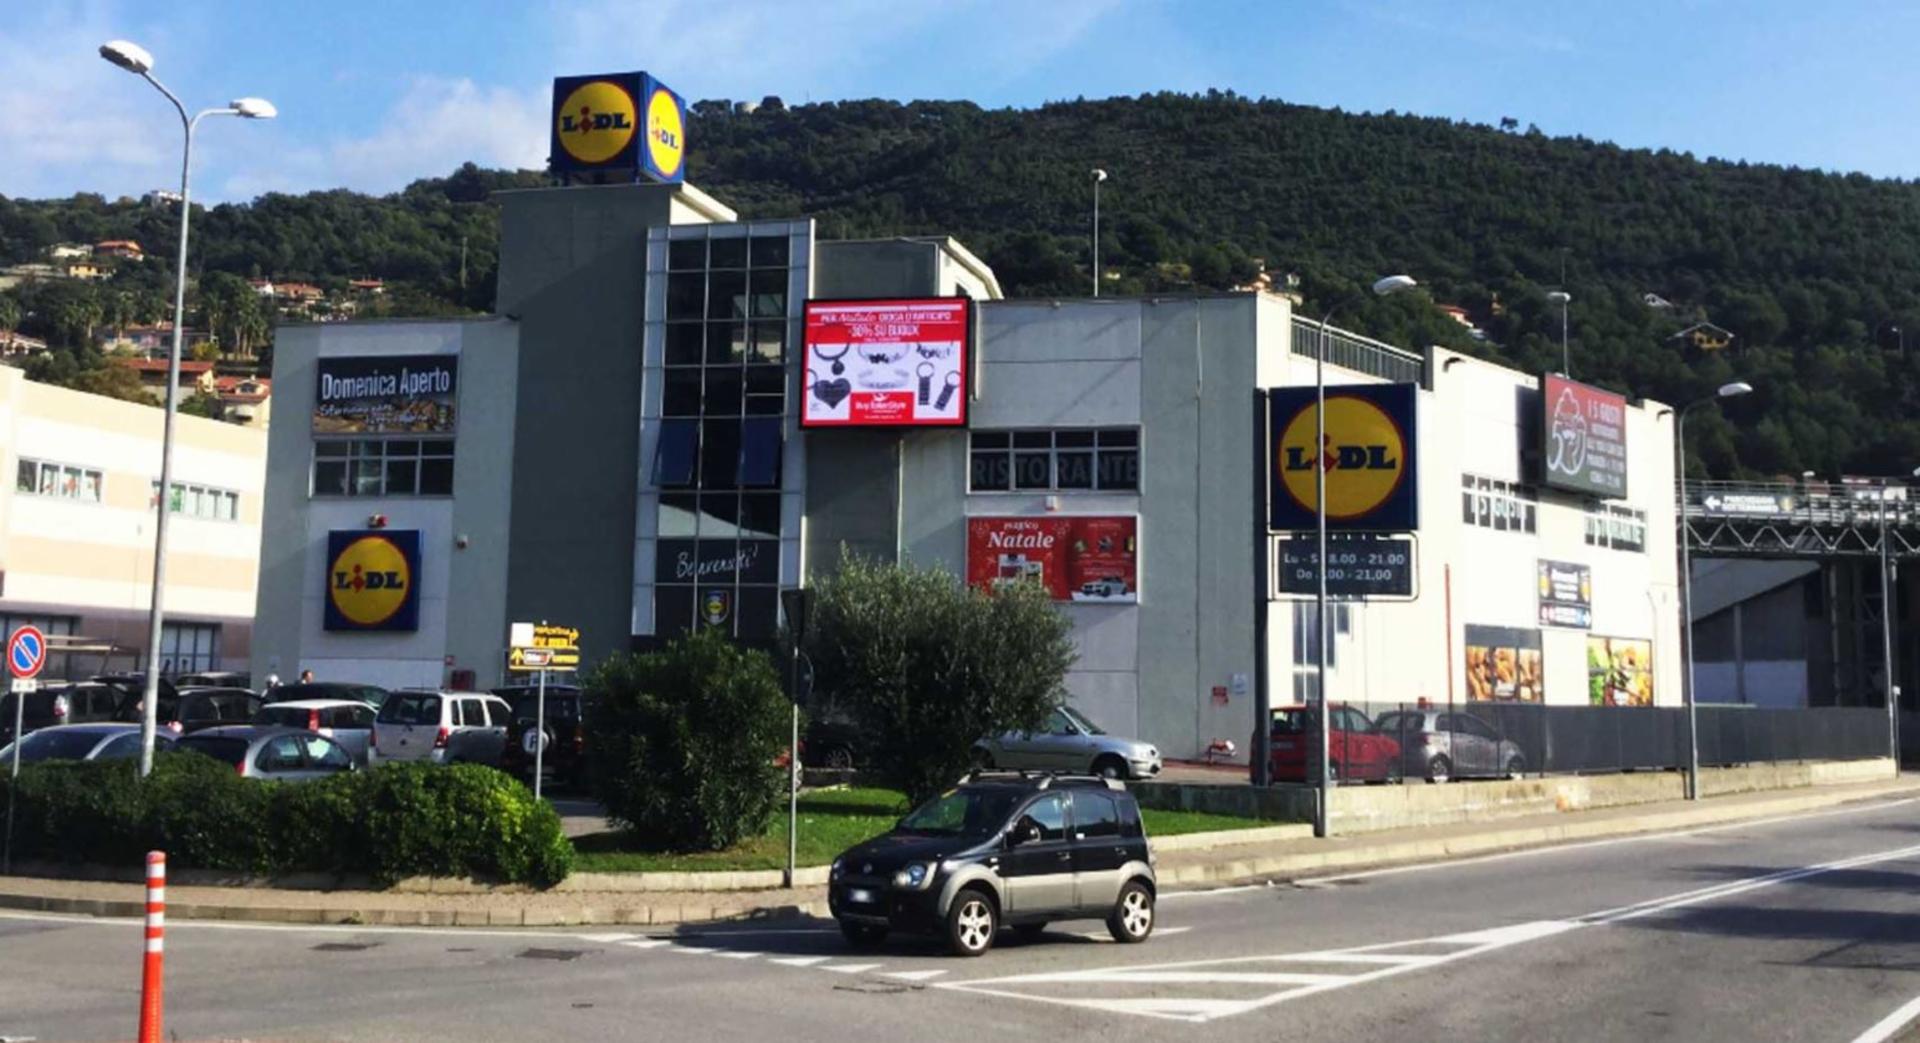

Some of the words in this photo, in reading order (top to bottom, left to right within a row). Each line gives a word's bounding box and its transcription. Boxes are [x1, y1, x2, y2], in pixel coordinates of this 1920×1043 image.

[322, 369, 396, 400] Domenica
[400, 367, 450, 398] Aperto
[974, 455, 1137, 486] RISTORANTE
[988, 531, 1054, 549] Natale
[1284, 553, 1298, 564] Lu
[1368, 553, 1405, 565] 21.00
[1296, 569, 1312, 580] Do
